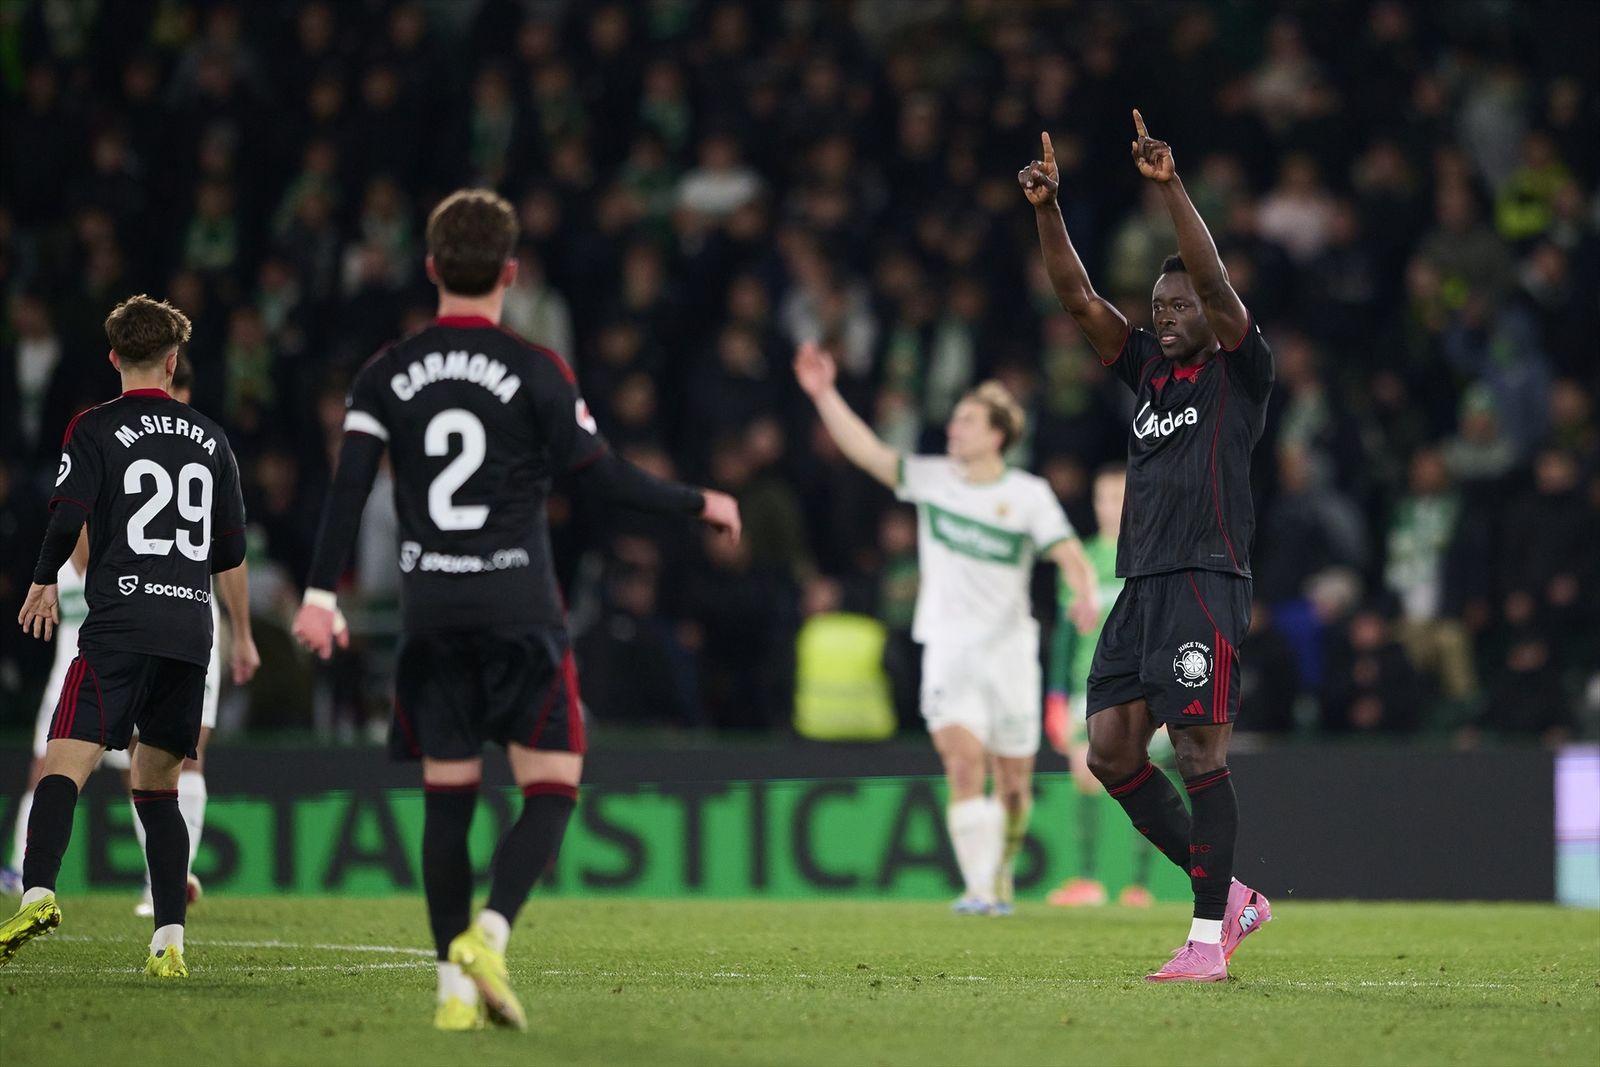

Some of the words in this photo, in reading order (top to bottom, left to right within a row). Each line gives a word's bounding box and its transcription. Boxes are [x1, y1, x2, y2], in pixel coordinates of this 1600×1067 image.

[390, 350, 522, 405] CARMONA
[114, 414, 217, 456] M.SIERRA
[424, 408, 491, 532] 2
[123, 459, 214, 562] 29
[1177, 641, 1194, 653] JUICE
[1194, 641, 1210, 653] TIME
